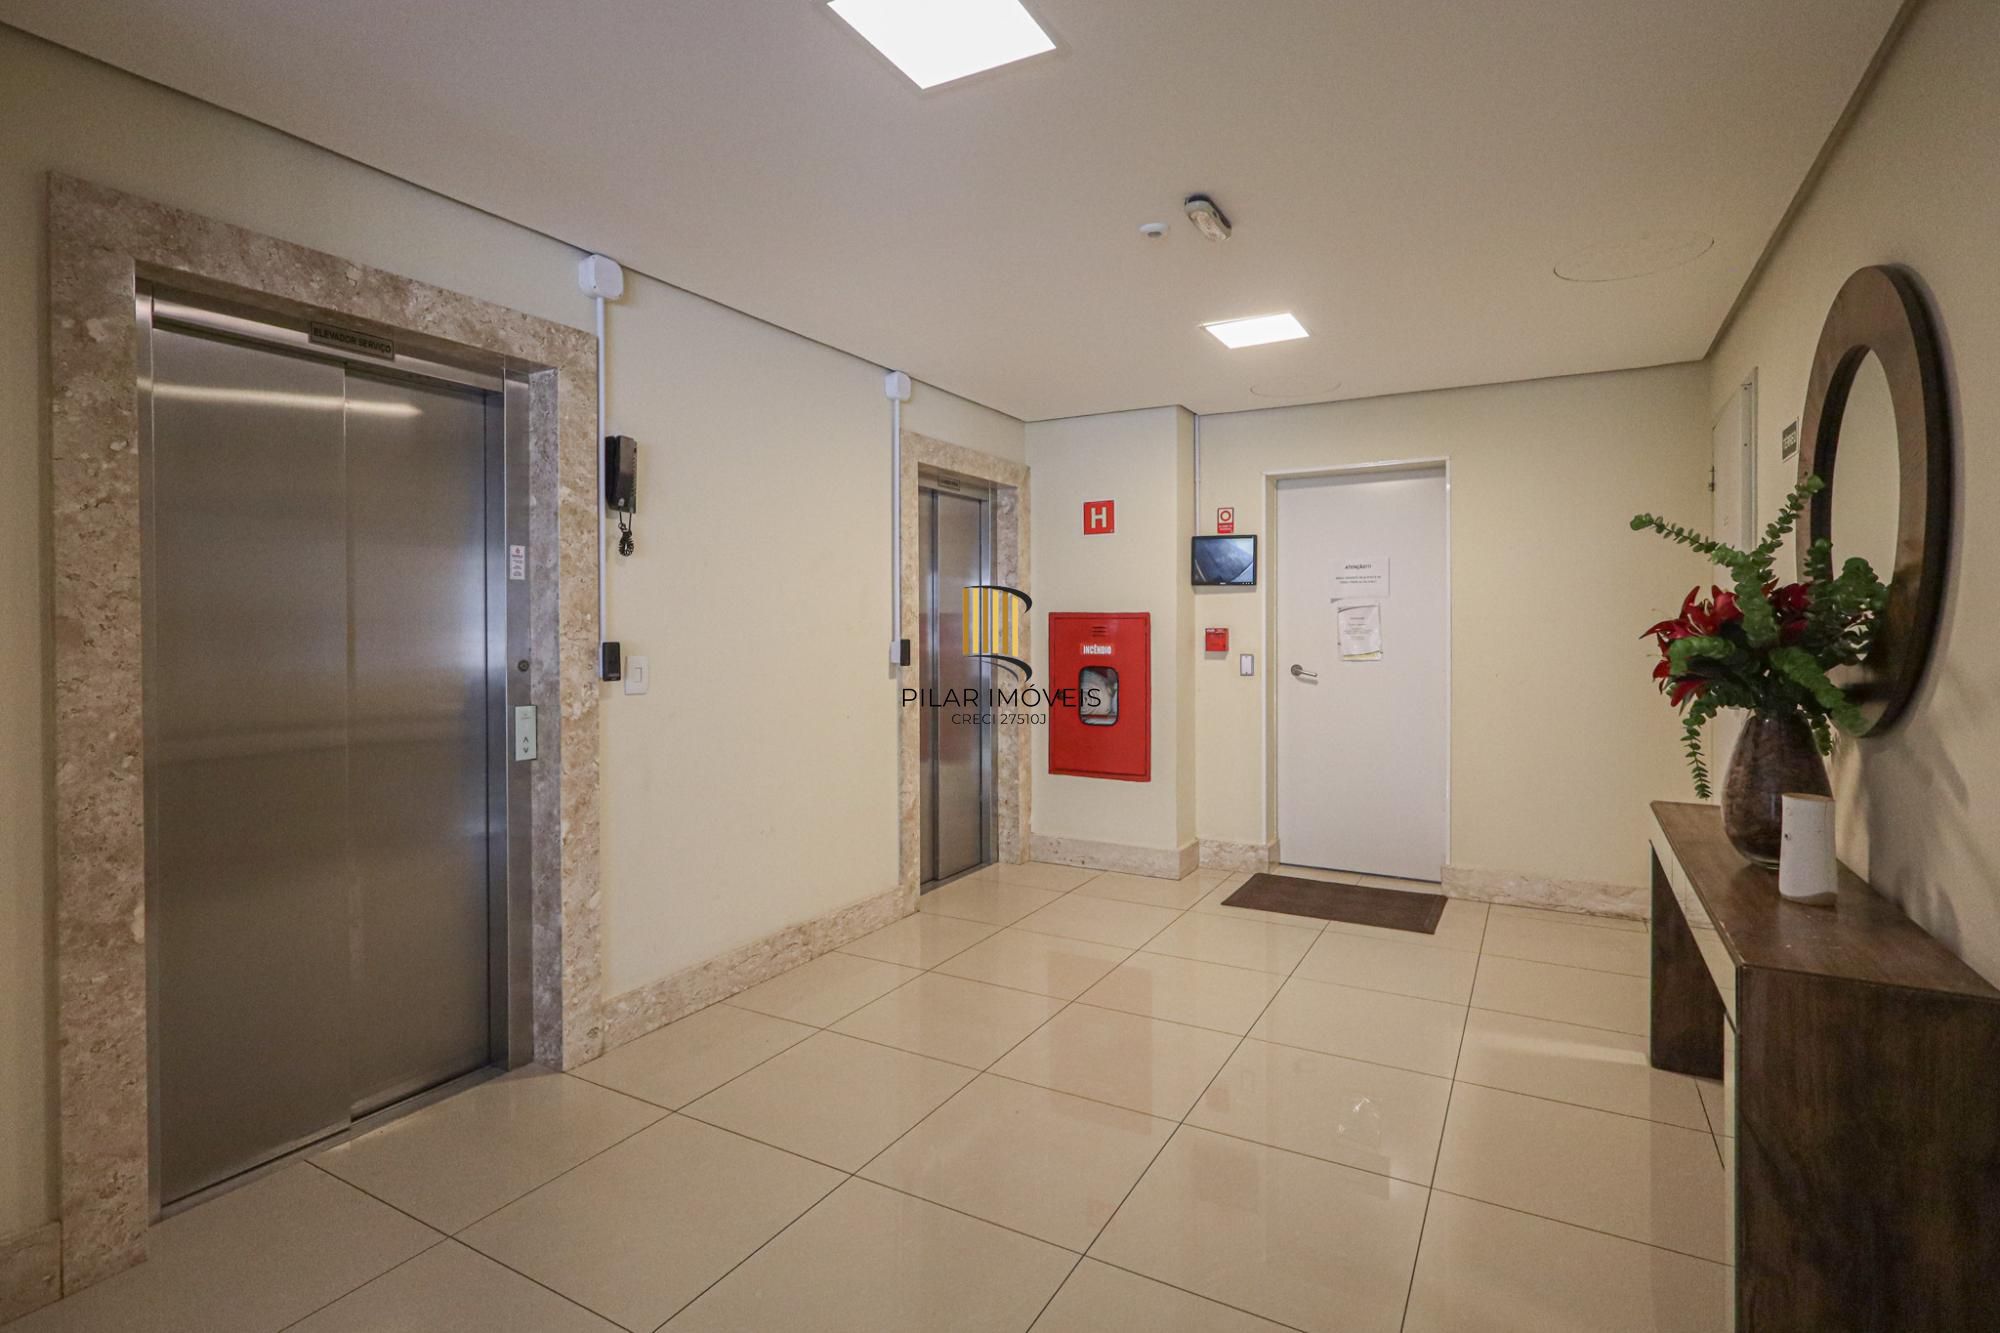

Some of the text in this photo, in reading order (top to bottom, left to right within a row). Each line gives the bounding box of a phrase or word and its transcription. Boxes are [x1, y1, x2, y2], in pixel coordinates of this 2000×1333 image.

[314, 327, 391, 353] ELEVADOR SERVIÇO
[1091, 506, 1107, 529] H
[1083, 643, 1112, 655] INCÊNDIO
